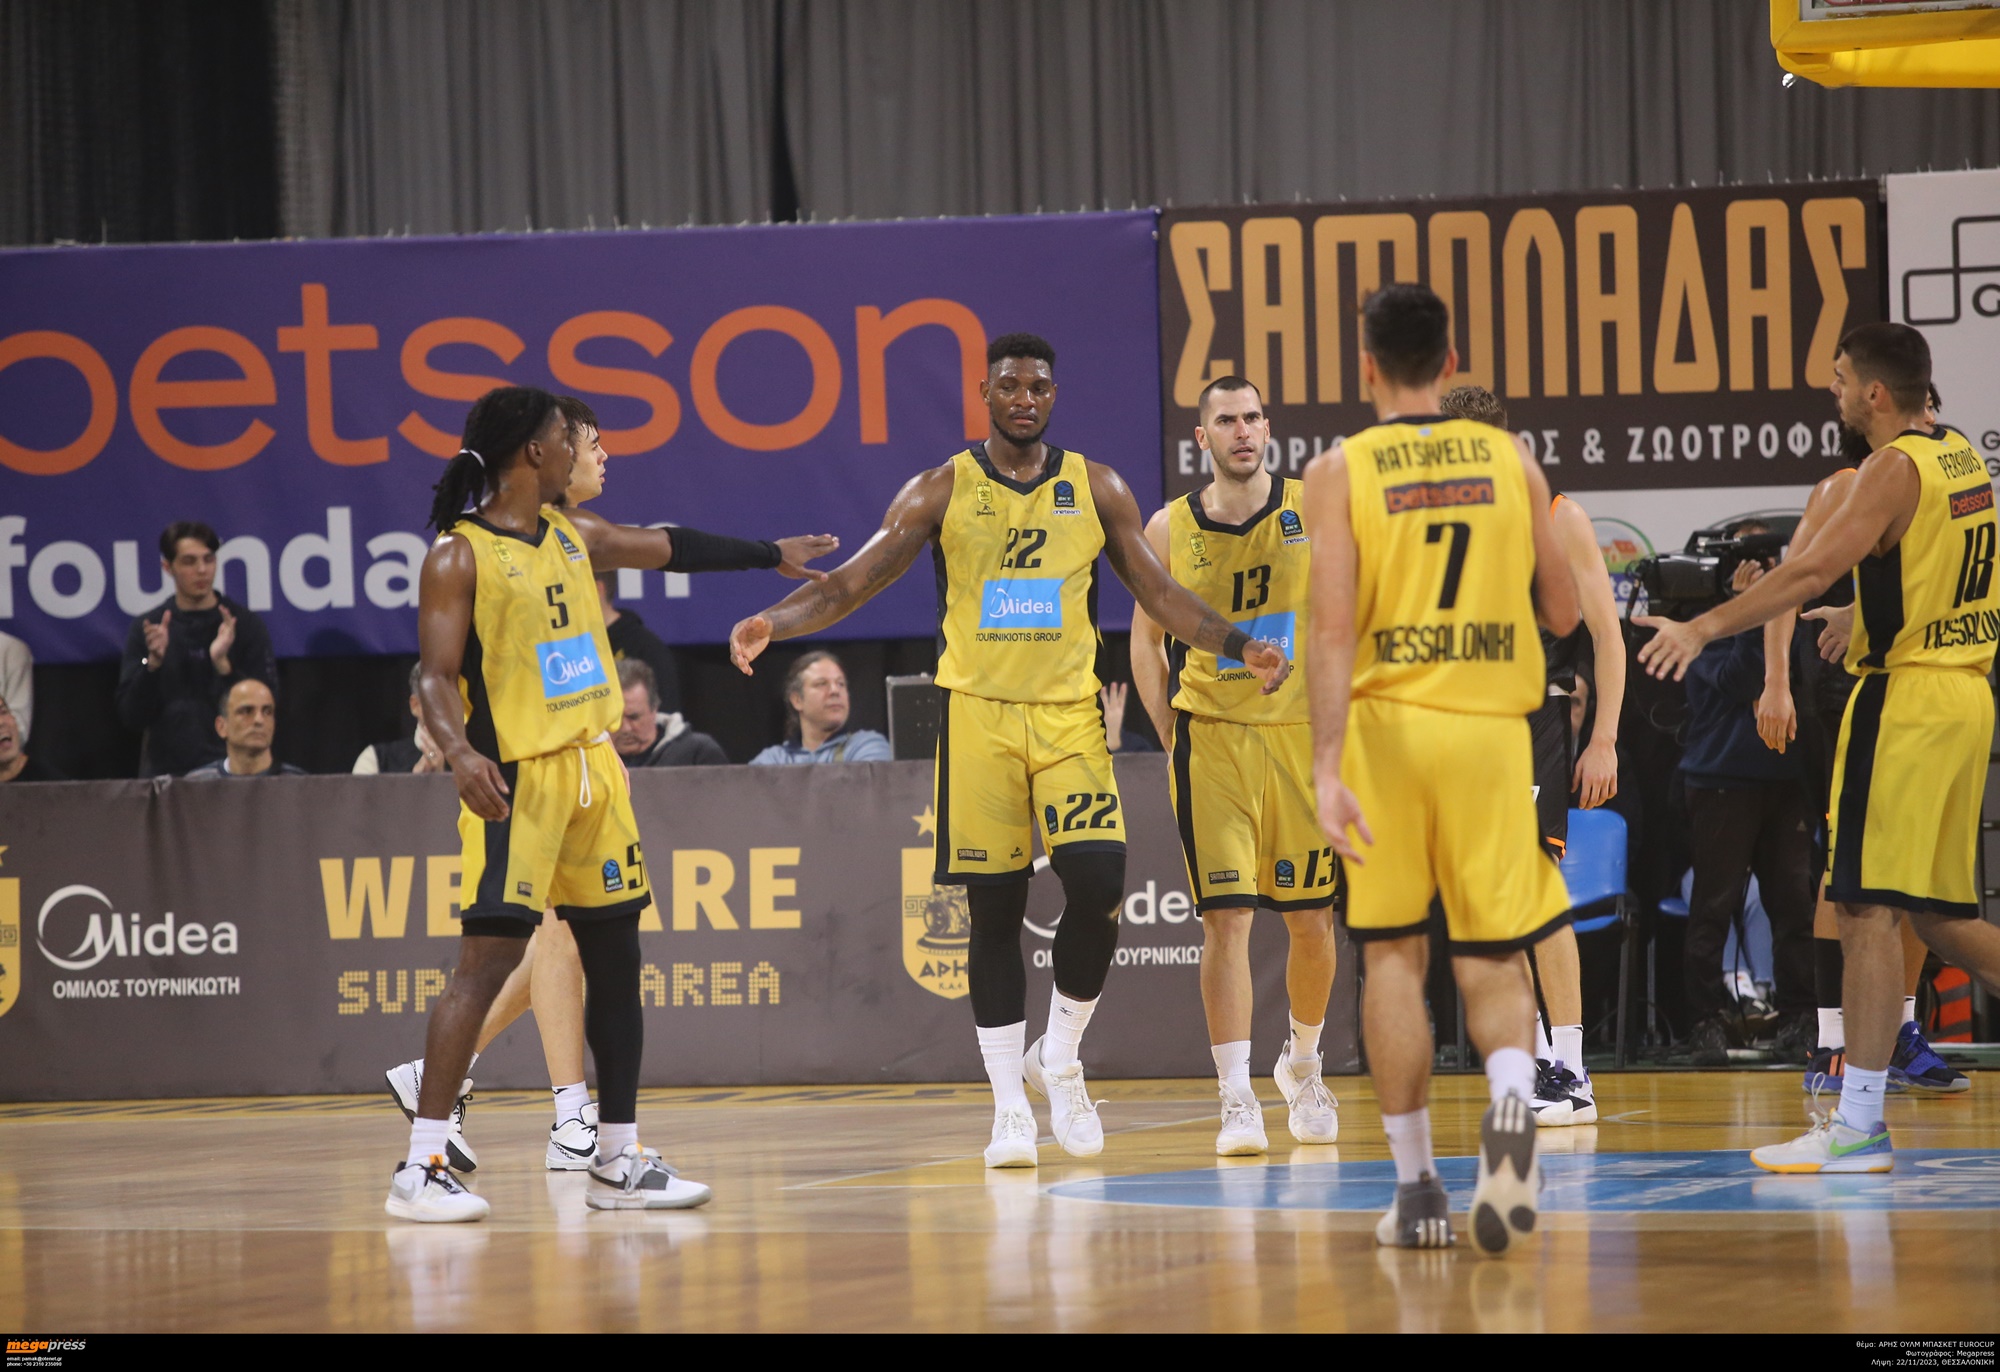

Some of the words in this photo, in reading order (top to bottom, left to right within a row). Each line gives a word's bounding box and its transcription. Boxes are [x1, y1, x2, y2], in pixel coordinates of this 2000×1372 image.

[1582, 428, 1605, 464] &
[1627, 419, 1842, 463] ΖΩΟΤΡΟΦΩ
[1937, 447, 1982, 480] PERSIDIS
[1951, 490, 1995, 515] betsson
[1000, 527, 1047, 570] 22
[1425, 521, 1471, 610] 7
[1953, 521, 1996, 609] 18
[545, 583, 569, 630] 5
[989, 596, 1054, 618] Midea
[1231, 564, 1271, 613] 13
[975, 632, 1031, 642] TOURNIKIOTIS
[1033, 632, 1062, 641] GROUP
[1063, 793, 1118, 833] 22
[1303, 847, 1336, 889] 13
[319, 855, 462, 939] WE
[36, 911, 239, 970] Midea
[53, 978, 120, 999] ΟΜΙΛΟΣ
[123, 976, 240, 998] ΤΟΥΡΝΙΚΙΩΤΗ
[639, 961, 780, 1007] AREA
[919, 959, 968, 979] ΑΡΗ
